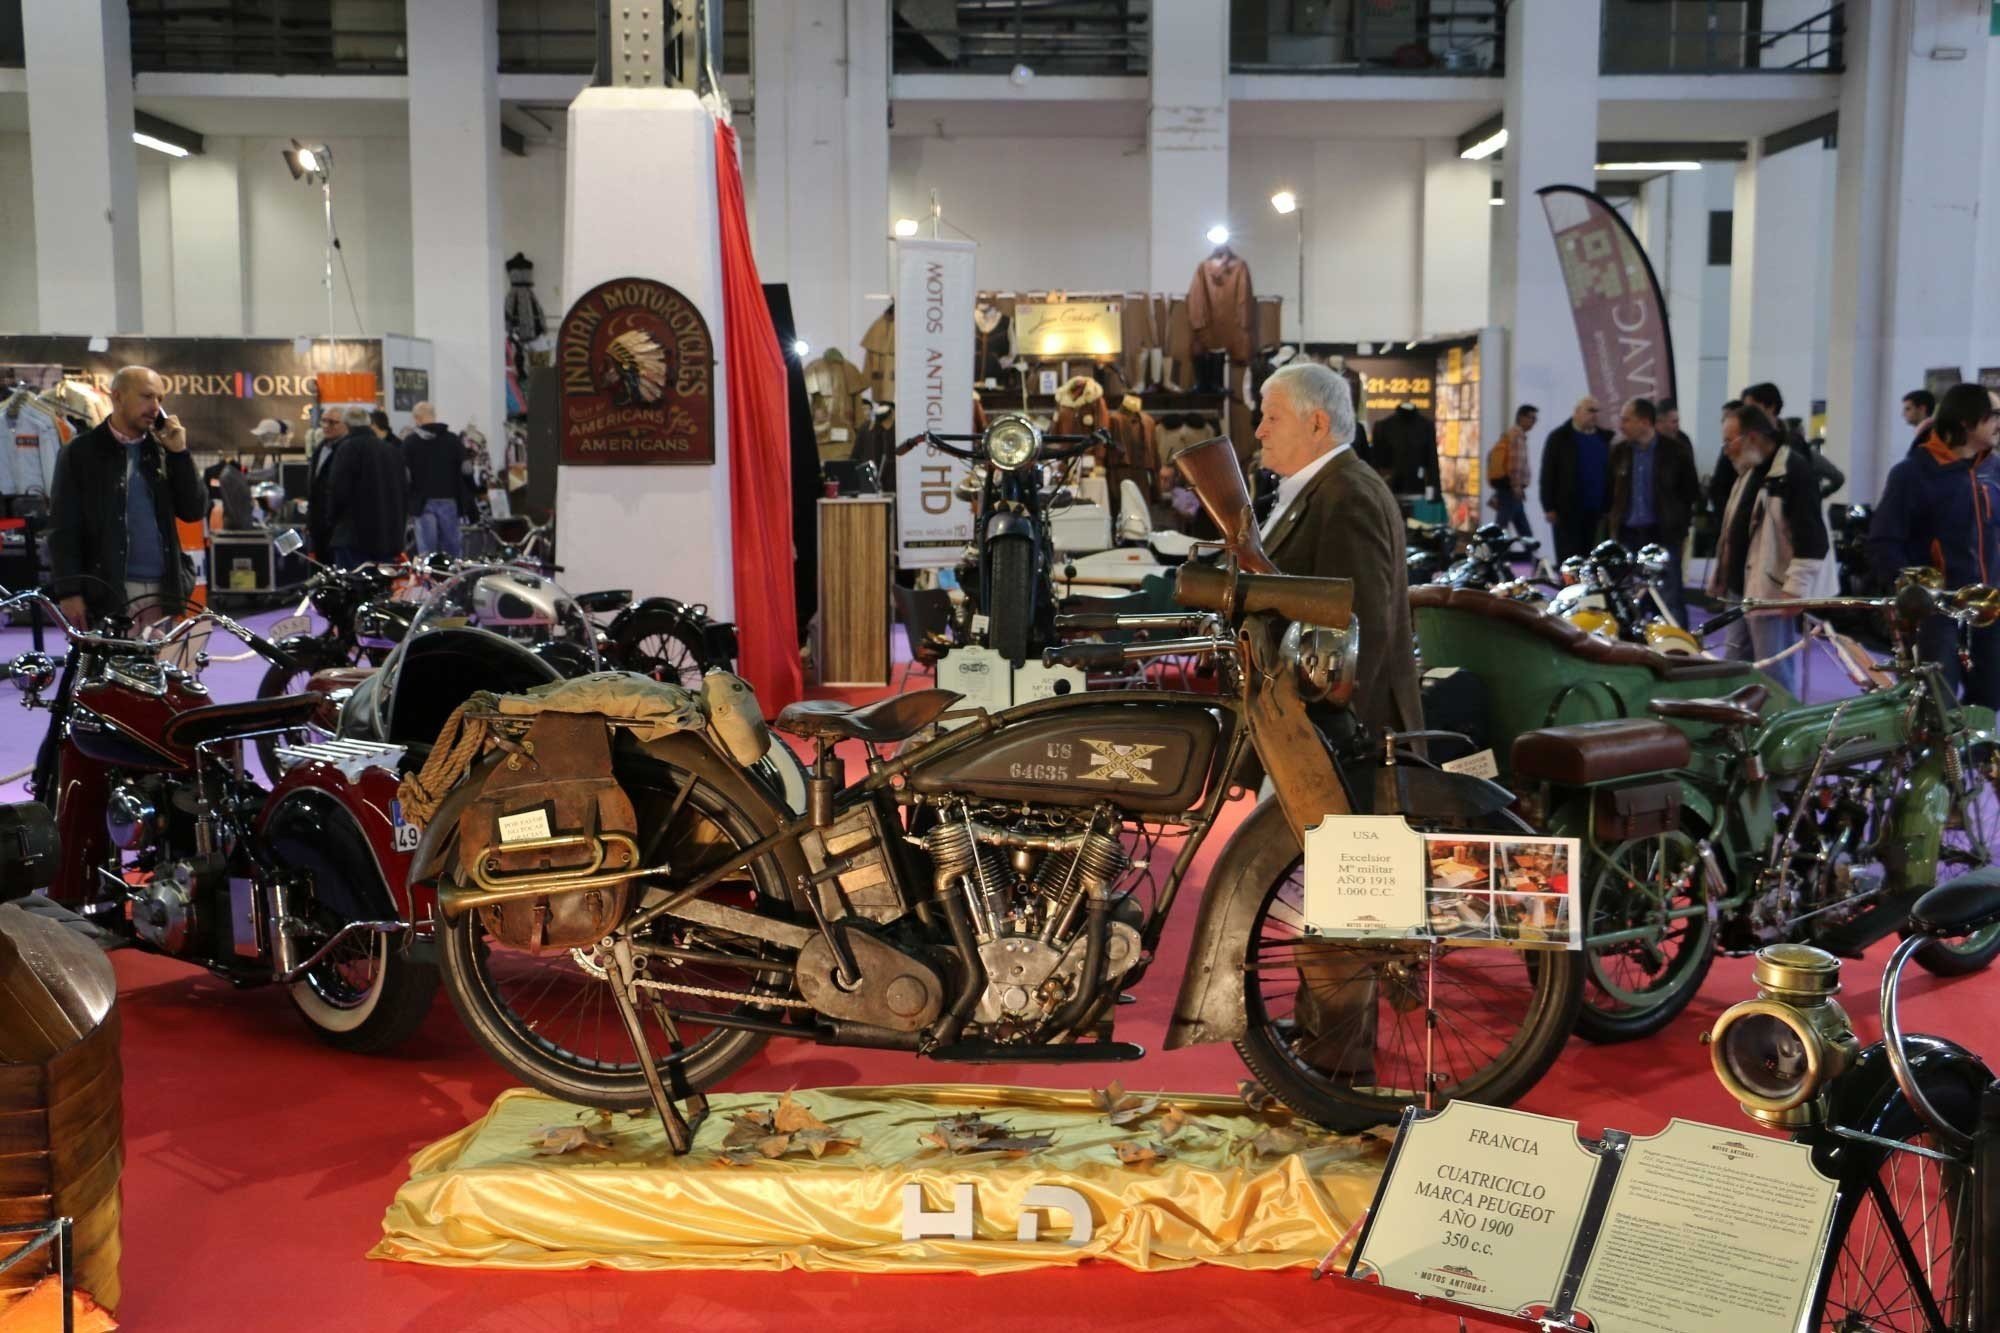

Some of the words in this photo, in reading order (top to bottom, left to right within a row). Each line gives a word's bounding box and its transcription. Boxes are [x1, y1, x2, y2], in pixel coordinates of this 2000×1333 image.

[927, 261, 944, 333] MOTOS
[563, 303, 603, 394] INDIAN
[601, 283, 708, 398] MOTORCYCLES
[568, 408, 665, 437] AMERICANS
[580, 438, 690, 451] AMERICANS
[920, 465, 952, 515] HD
[1047, 742, 1073, 759] US
[1009, 762, 1069, 781] 64635
[1353, 831, 1379, 839] USA
[1341, 853, 1391, 862] Excelsior
[1336, 874, 1366, 885] AÑO
[1370, 876, 1396, 885] 1918
[1357, 864, 1393, 874] militar
[1336, 887, 1367, 896] 1.000
[1468, 1128, 1539, 1156] FRANCIA
[1437, 1164, 1546, 1200] CUATRICICLO
[1415, 1181, 1473, 1207] MARCA
[1477, 1194, 1556, 1225] PEUGEOT
[1439, 1208, 1476, 1229] AÑO
[1480, 1217, 1514, 1238] 1900
[1442, 1231, 1469, 1250] 350
[1420, 1271, 1446, 1285] MOTOS
[1450, 1278, 1487, 1294] ANTIGUAS
